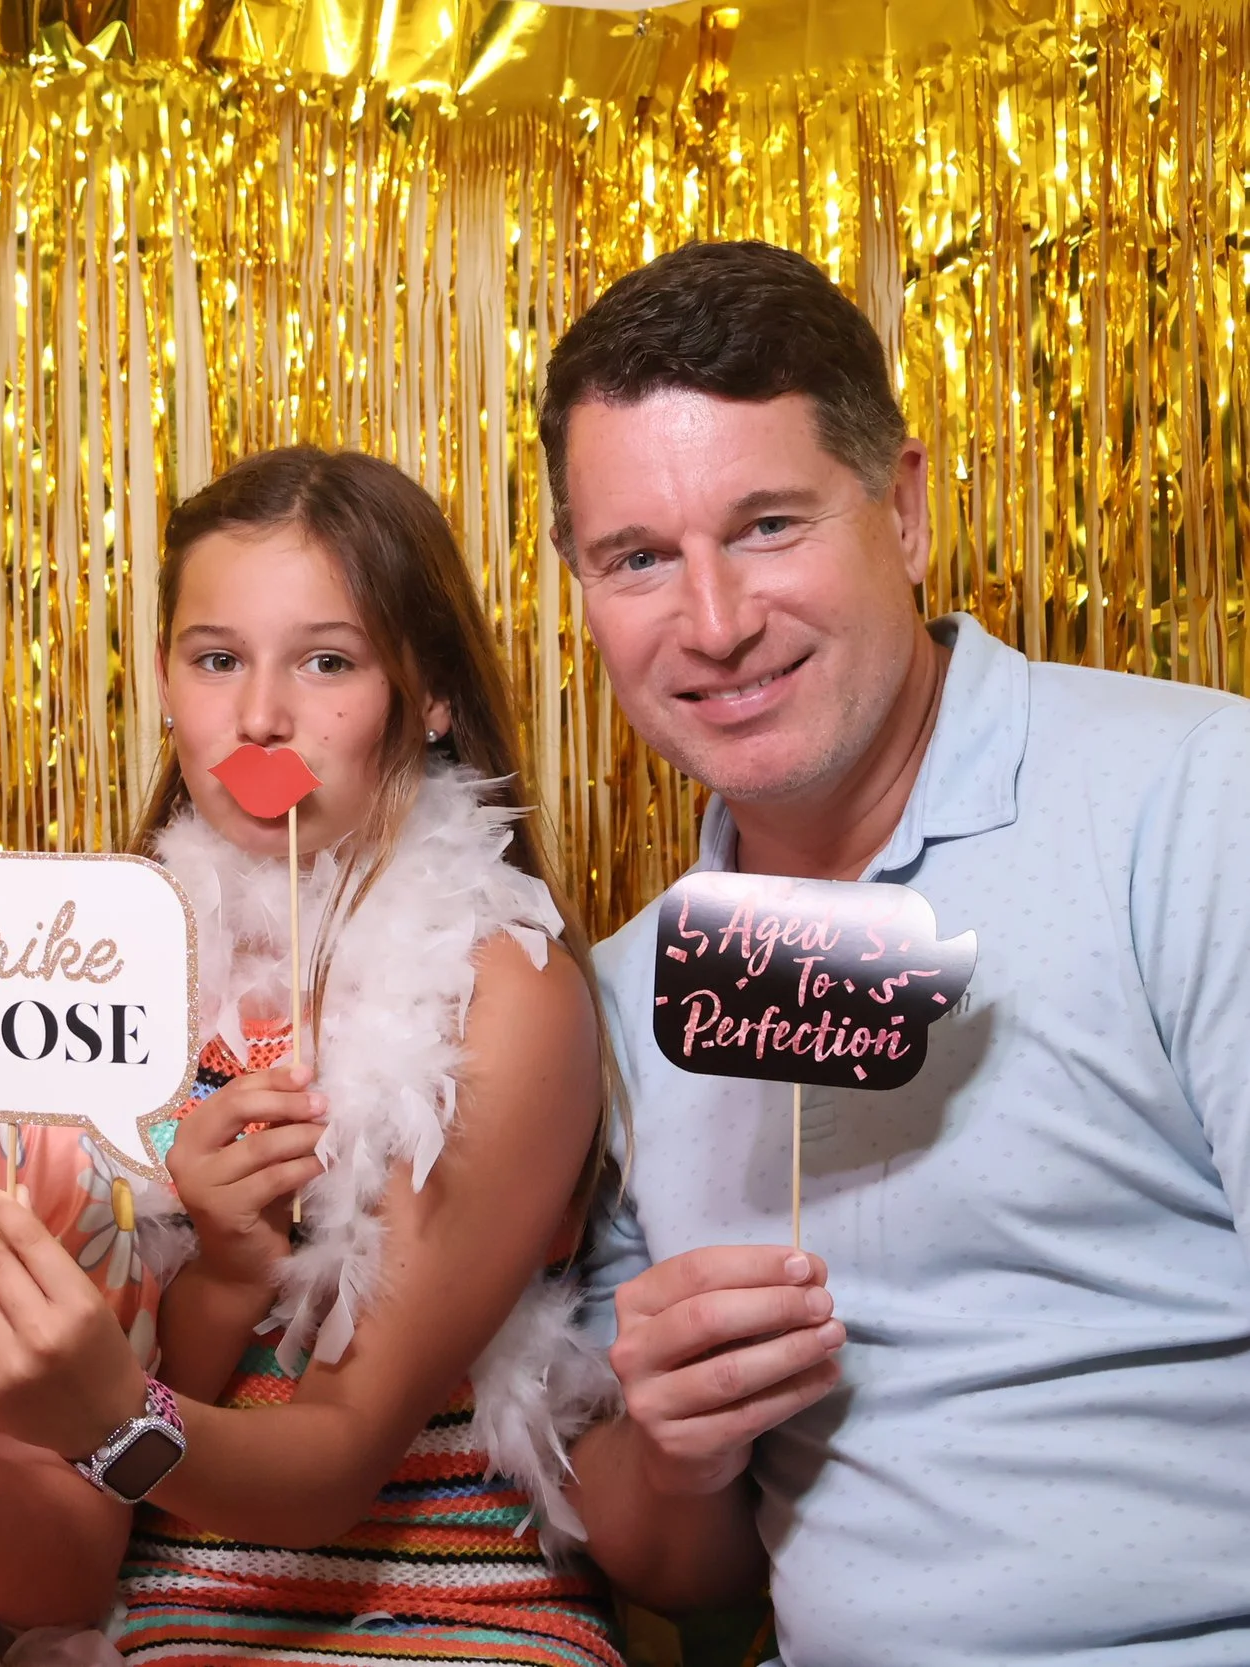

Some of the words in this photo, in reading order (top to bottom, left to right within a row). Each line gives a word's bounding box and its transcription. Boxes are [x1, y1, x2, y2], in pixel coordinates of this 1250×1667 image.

[718, 896, 842, 977] Aged
[793, 956, 837, 1007] To
[680, 989, 911, 1062] Perfection
